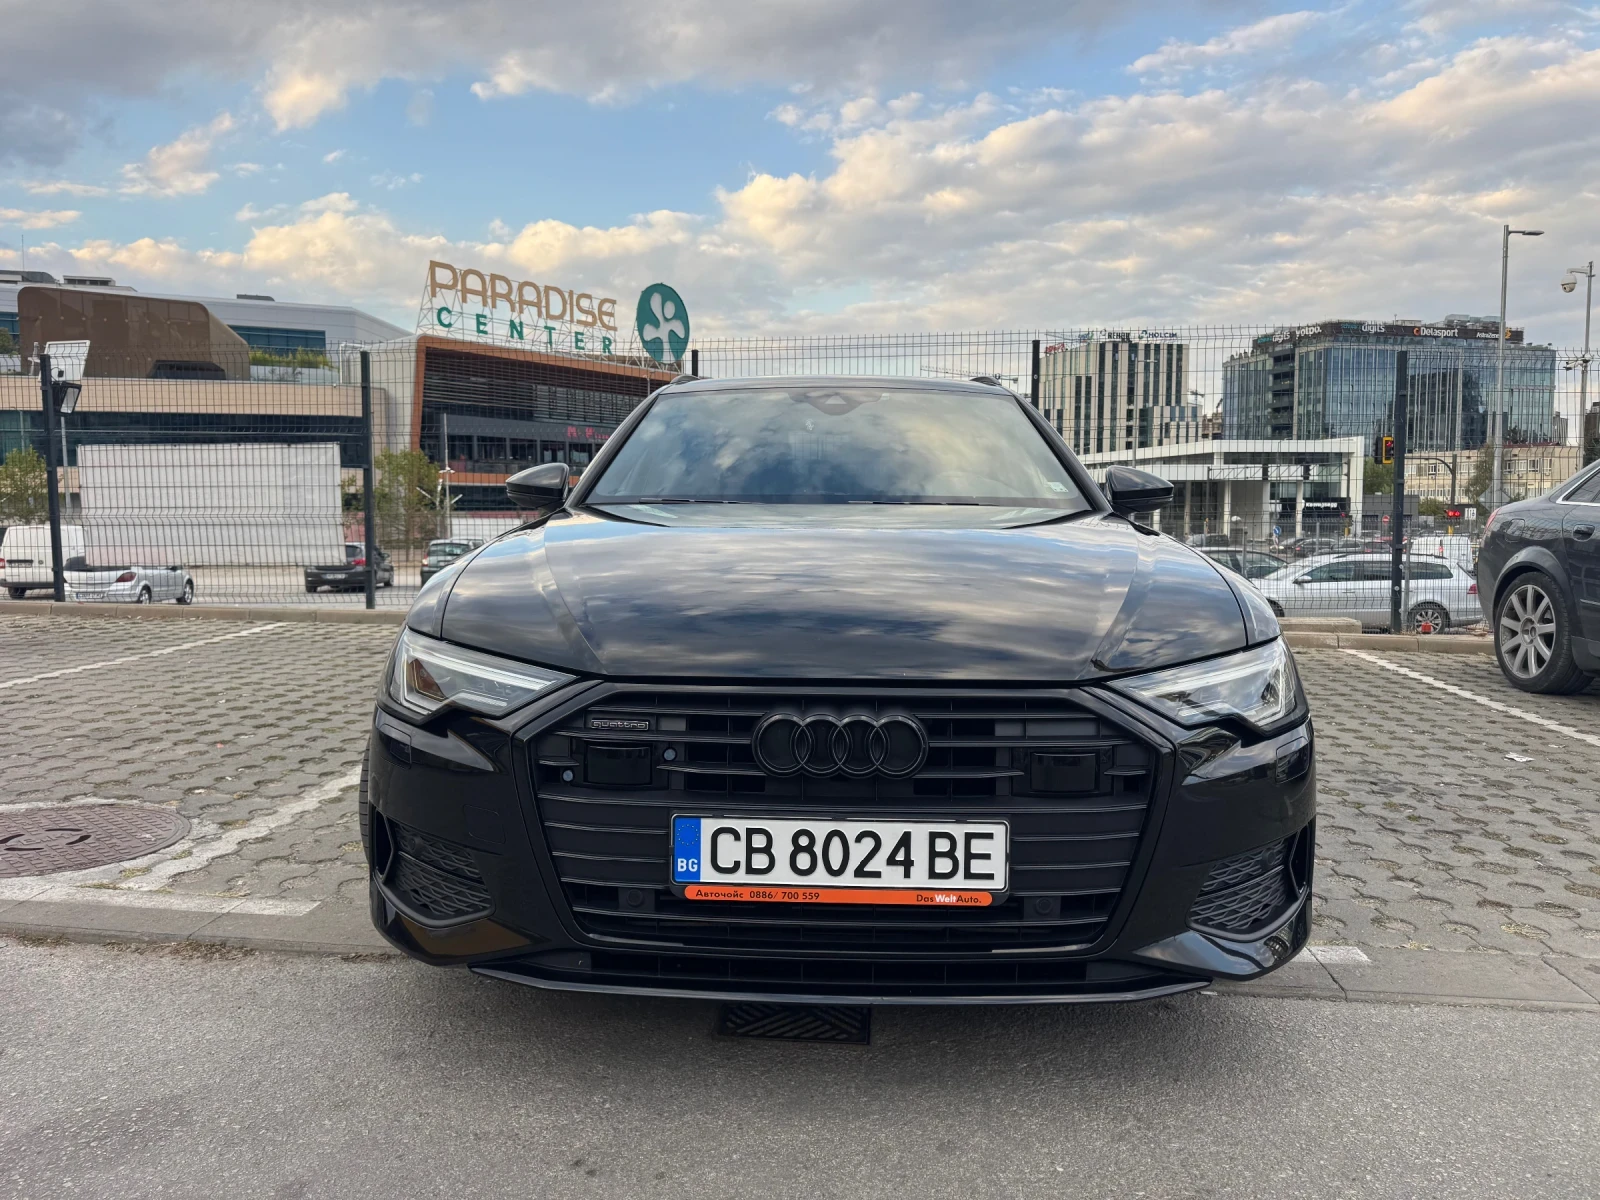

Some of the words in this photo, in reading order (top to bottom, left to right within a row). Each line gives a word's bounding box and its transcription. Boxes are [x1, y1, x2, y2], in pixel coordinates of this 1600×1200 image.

[430, 260, 618, 332] PARADISE
[436, 306, 613, 355] CENTER
[1361, 322, 1385, 334] digits
[1420, 326, 1459, 339] Delasport
[593, 721, 646, 729] quattro
[710, 826, 776, 875] CB
[789, 828, 915, 879] 8024
[928, 830, 995, 881] BE
[677, 858, 699, 873] BG
[695, 889, 744, 899] Авточойс
[749, 890, 778, 900] 0886/
[781, 891, 799, 900] 700
[802, 892, 820, 900] 559
